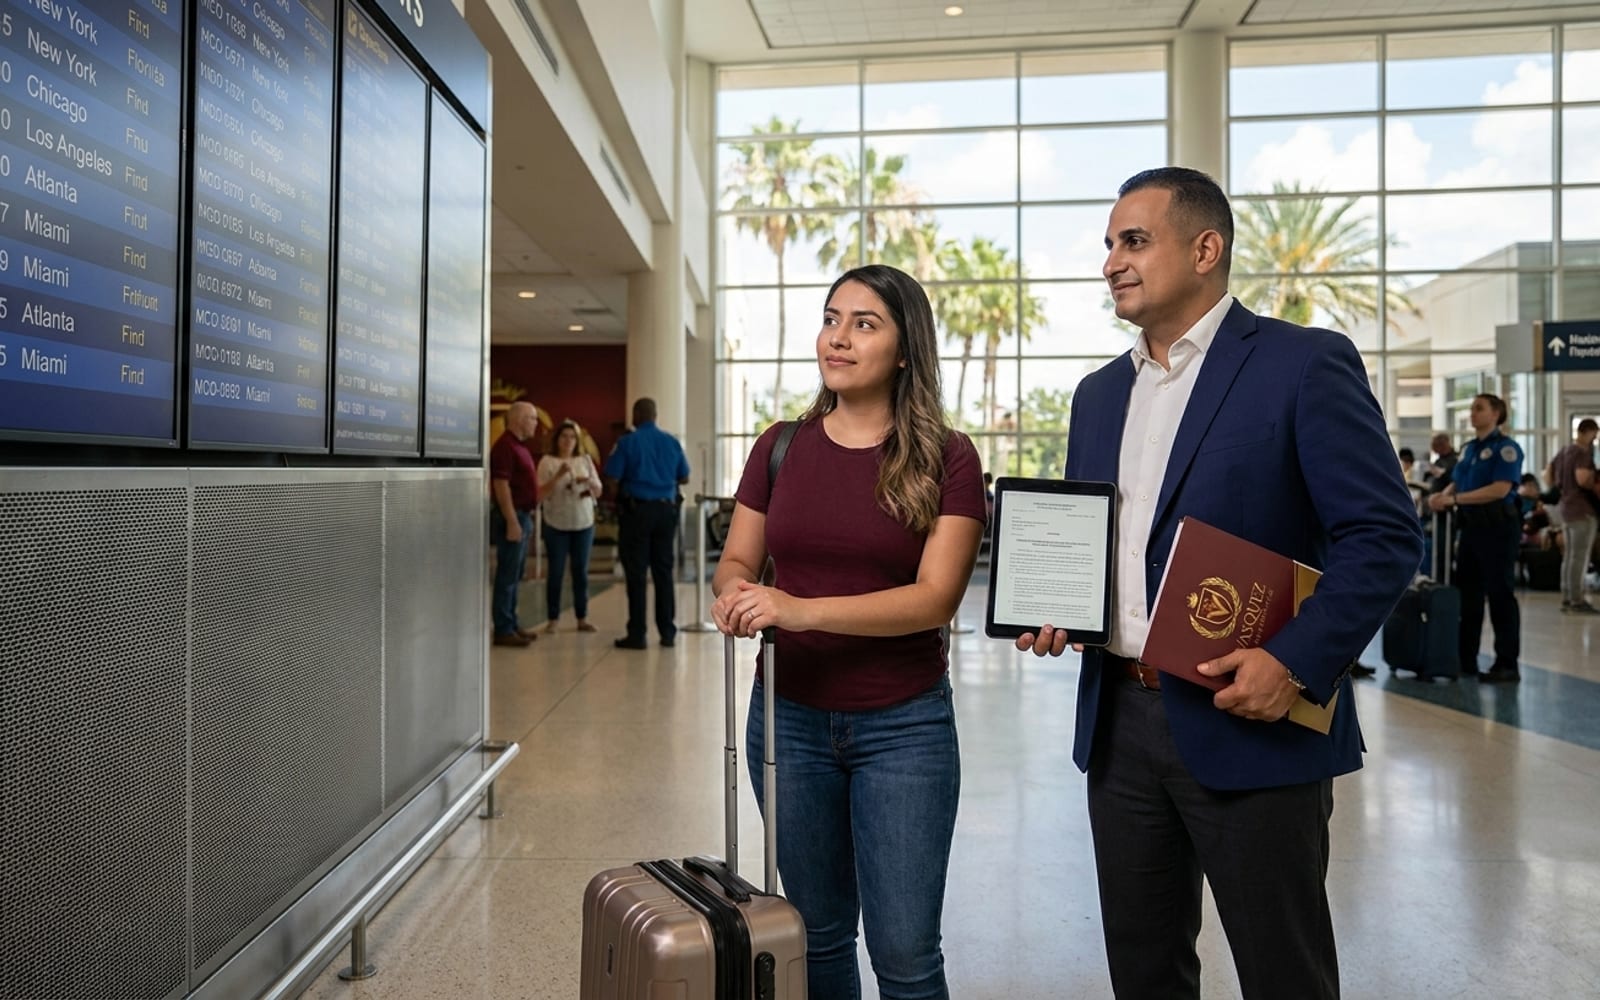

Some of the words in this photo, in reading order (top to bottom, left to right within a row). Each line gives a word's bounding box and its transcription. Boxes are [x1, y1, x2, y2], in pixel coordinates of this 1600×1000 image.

[67, 6, 98, 46] York
[27, 27, 62, 65] New
[66, 50, 97, 87] York
[27, 74, 87, 123] Chicago
[26, 118, 53, 150] Los
[56, 133, 113, 177] Angeles
[25, 165, 78, 204] Atlanta
[25, 209, 70, 245] Miami
[123, 246, 146, 269] Find
[24, 255, 69, 288] Miami
[21, 302, 75, 333] Atlanta
[122, 325, 144, 347] Find
[21, 347, 67, 375] Miami
[121, 365, 144, 385] Find
